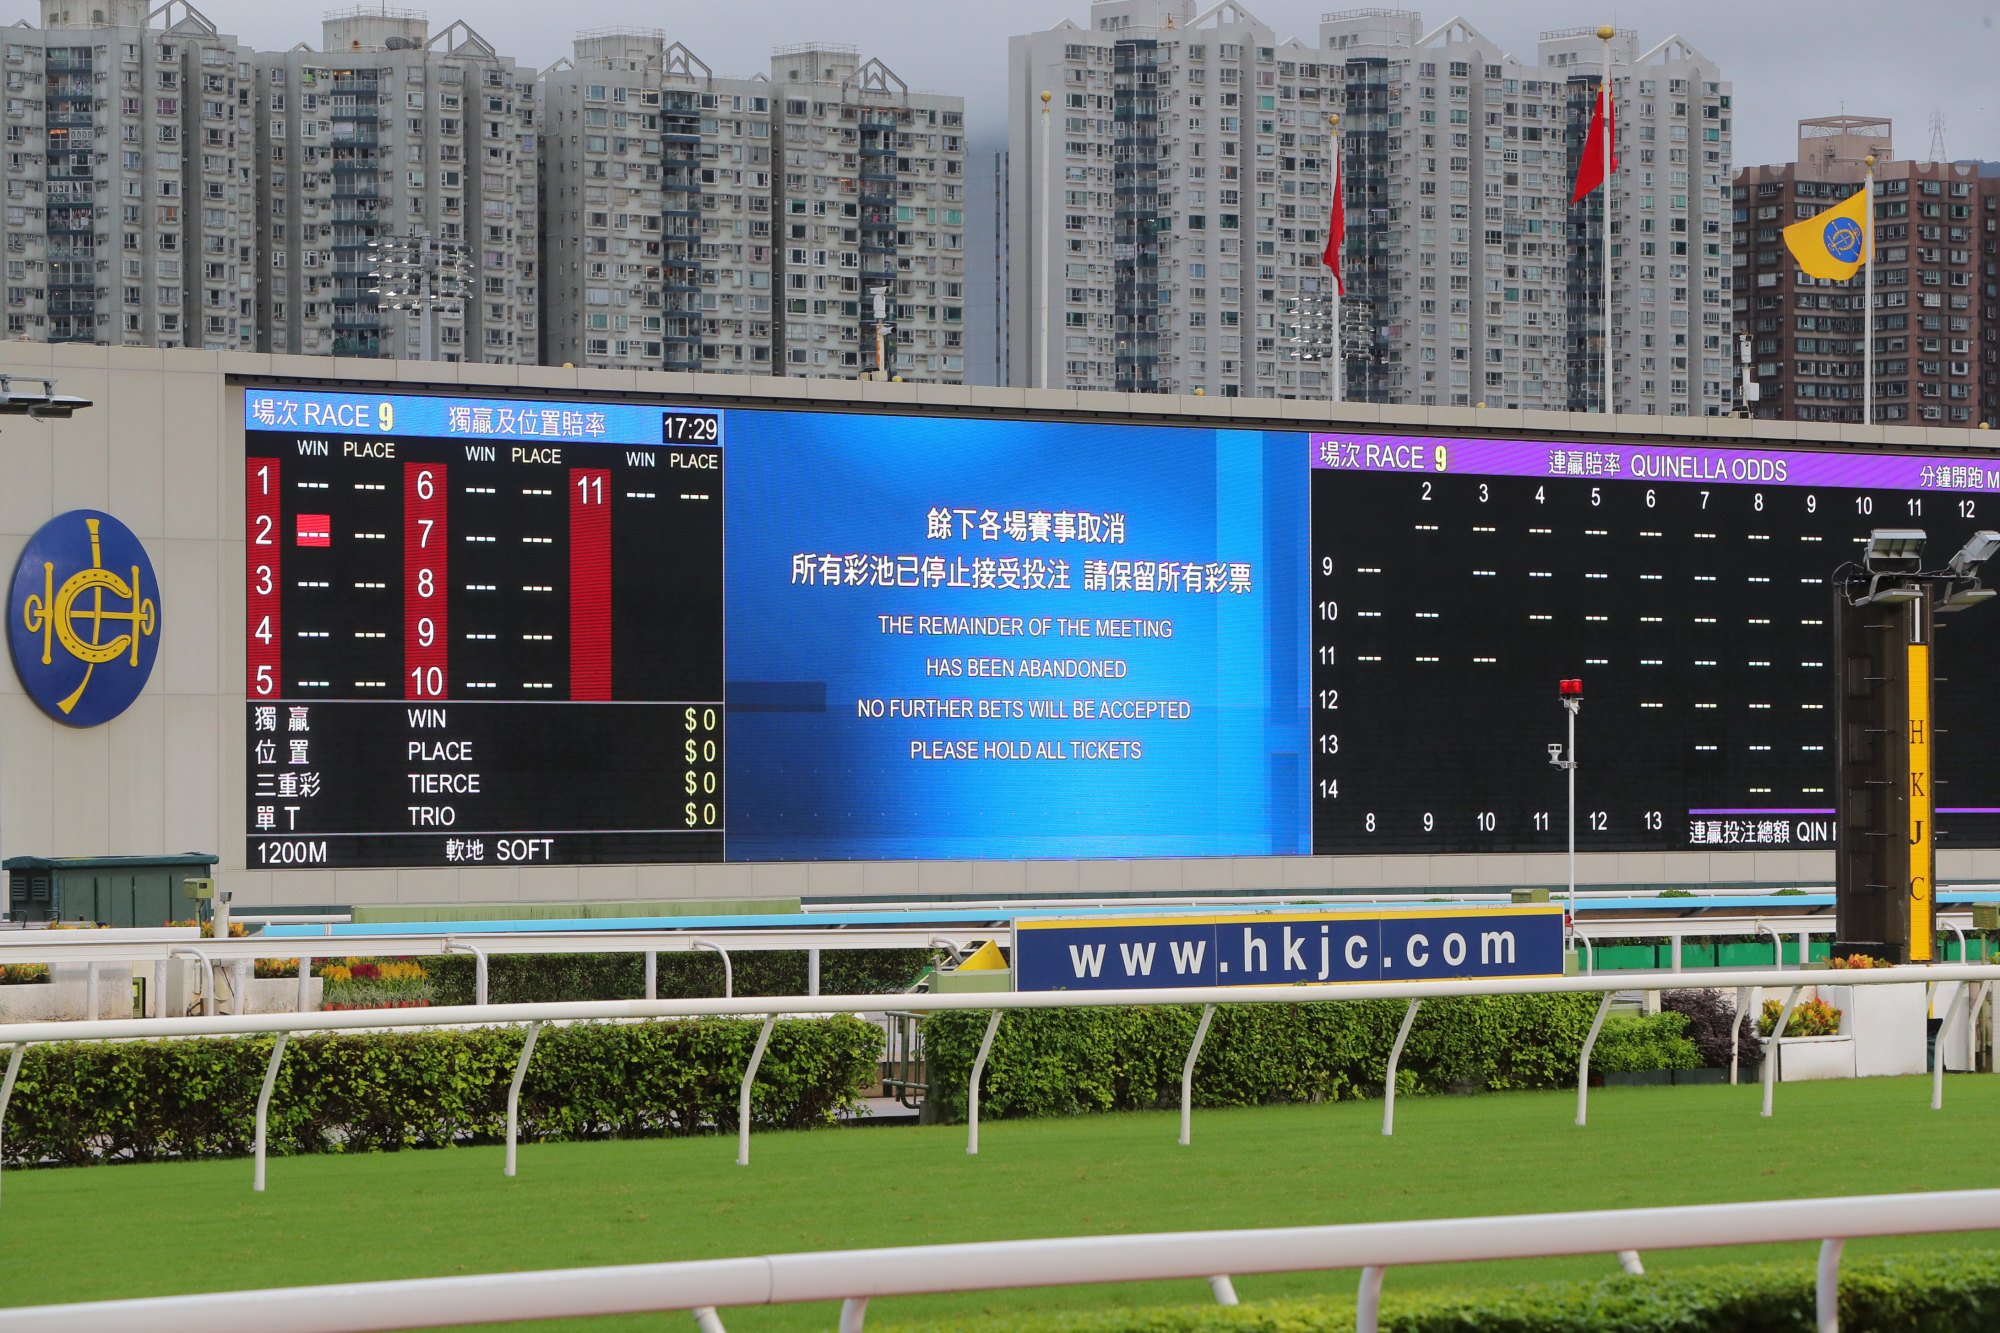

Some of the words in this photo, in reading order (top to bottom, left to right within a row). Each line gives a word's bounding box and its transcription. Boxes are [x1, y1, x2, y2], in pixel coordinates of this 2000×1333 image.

[252, 398, 299, 426] 場次
[304, 402, 371, 428] RACE
[378, 402, 394, 431] 9
[448, 405, 606, 438] 獨贏及位置賠率
[664, 417, 718, 440] 17:29
[297, 439, 328, 456] WIN
[343, 441, 395, 459] PLACE
[465, 445, 495, 462] WIN
[512, 447, 562, 464] PLACE
[625, 451, 655, 468] WIN
[670, 452, 718, 470] PLACE
[1319, 440, 1361, 469] 場次
[1366, 444, 1425, 469] RACE
[1435, 445, 1447, 472] 9
[1548, 449, 1621, 477] 連贏賠率
[1630, 454, 1728, 480] QUINELLA
[1731, 458, 1788, 482] ODDS
[1919, 465, 1984, 489] 分鐘開跑
[257, 465, 268, 495] 1
[417, 470, 434, 500] 6
[577, 475, 602, 505] 11
[1421, 481, 1432, 501] 2
[1479, 483, 1489, 503] 3
[1535, 485, 1545, 504] 4
[1591, 487, 1601, 507] 5
[1646, 489, 1656, 508] 6
[1700, 491, 1710, 510] 7
[1754, 492, 1764, 512] 8
[1806, 494, 1816, 513] 9
[1855, 496, 1873, 515] 10
[1907, 498, 1921, 517] 11
[1958, 500, 1975, 518] 12
[255, 514, 272, 545] 2
[417, 519, 434, 548] 7
[927, 506, 1125, 544] 餘下各場賽事取消
[791, 553, 1071, 590] 所有彩池已停止接受投注
[1083, 559, 1252, 594] 請保留所有彩票
[1322, 556, 1333, 576] 9
[256, 565, 273, 595] 3
[417, 568, 434, 598] 8
[1318, 601, 1338, 621] 10
[254, 615, 273, 645] 4
[417, 617, 434, 647] 9
[877, 615, 914, 634] THE
[919, 615, 1024, 636] REMAINDER
[1028, 618, 1052, 636] OF
[1056, 618, 1091, 637] THE
[1095, 618, 1173, 638] MEETING
[1319, 645, 1335, 665] 11
[926, 658, 963, 677] HAS
[967, 658, 1015, 677] BEEN
[1018, 659, 1127, 678] ABANDONED
[256, 665, 273, 695] 5
[411, 666, 443, 696] 10
[858, 699, 885, 718] NO
[890, 699, 974, 718] FURTHER
[978, 699, 1024, 718] BETS
[1028, 700, 1069, 719] WILL
[1072, 700, 1096, 719] BE
[1098, 700, 1191, 719] ACCEPTED
[1319, 689, 1338, 710] 12
[407, 708, 446, 728] WIN
[408, 741, 473, 761] PLACE
[911, 740, 979, 760] PLEASE
[984, 741, 1032, 760] HOLD
[1035, 741, 1067, 759] ALL
[1070, 741, 1142, 759] TICKETS
[1319, 734, 1339, 754] 13
[254, 771, 321, 798] 三重彩
[407, 773, 480, 794] TIERCE
[1319, 779, 1339, 799] 14
[407, 806, 456, 826] TRIO
[1365, 812, 1376, 832] 8
[1423, 812, 1434, 832] 9
[1477, 811, 1496, 832] 10
[1533, 811, 1548, 831] 11
[1589, 811, 1608, 831] 12
[1644, 811, 1662, 830] 13
[1689, 819, 1790, 844] 連贏投注總額
[1796, 821, 1827, 843] QIN
[258, 841, 327, 864] 1200M
[445, 838, 484, 862] 軟地
[496, 839, 554, 861] SOFT
[1068, 926, 1517, 981] www.hkjc.com
